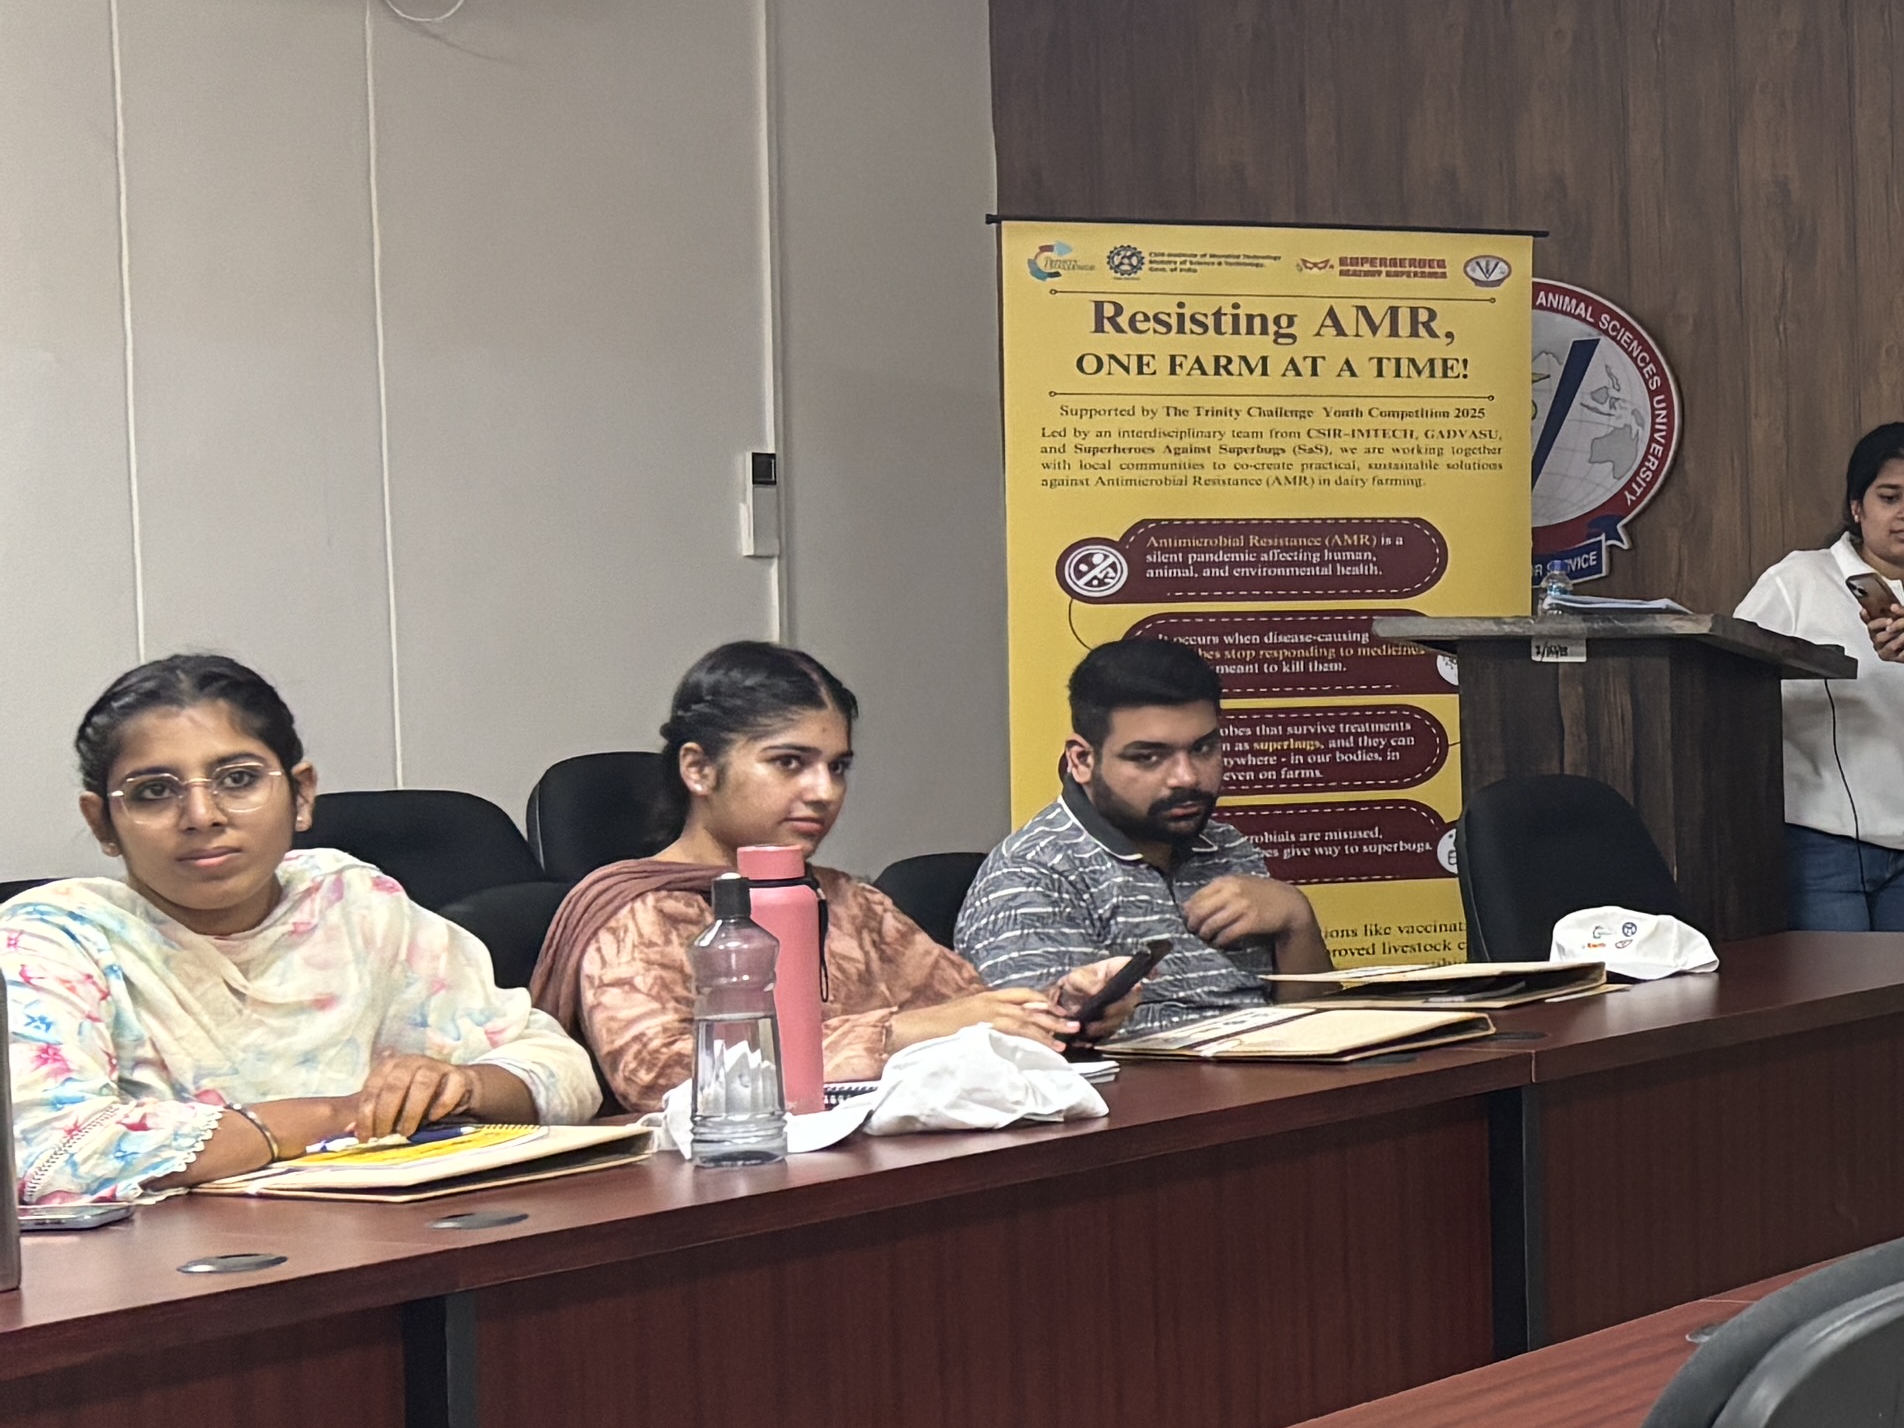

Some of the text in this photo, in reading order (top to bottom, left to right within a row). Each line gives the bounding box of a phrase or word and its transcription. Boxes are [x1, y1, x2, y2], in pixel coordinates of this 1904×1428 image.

[1092, 300, 1454, 346] Resisting AMR,
[1076, 353, 1468, 379] ONE FARM AT A TIME!
[1536, 290, 1668, 506] ANIMAL SCIENCES UNIVERSITY
[1060, 405, 1485, 421] Supported by The Trinity Challenge Youth Competition 2025
[1147, 534, 1404, 547] Antimicrobial Resistance (AMR) is a
[1146, 549, 1376, 563] silent pandemic affecting human,
[1146, 562, 1382, 578] animal, and environmental health.
